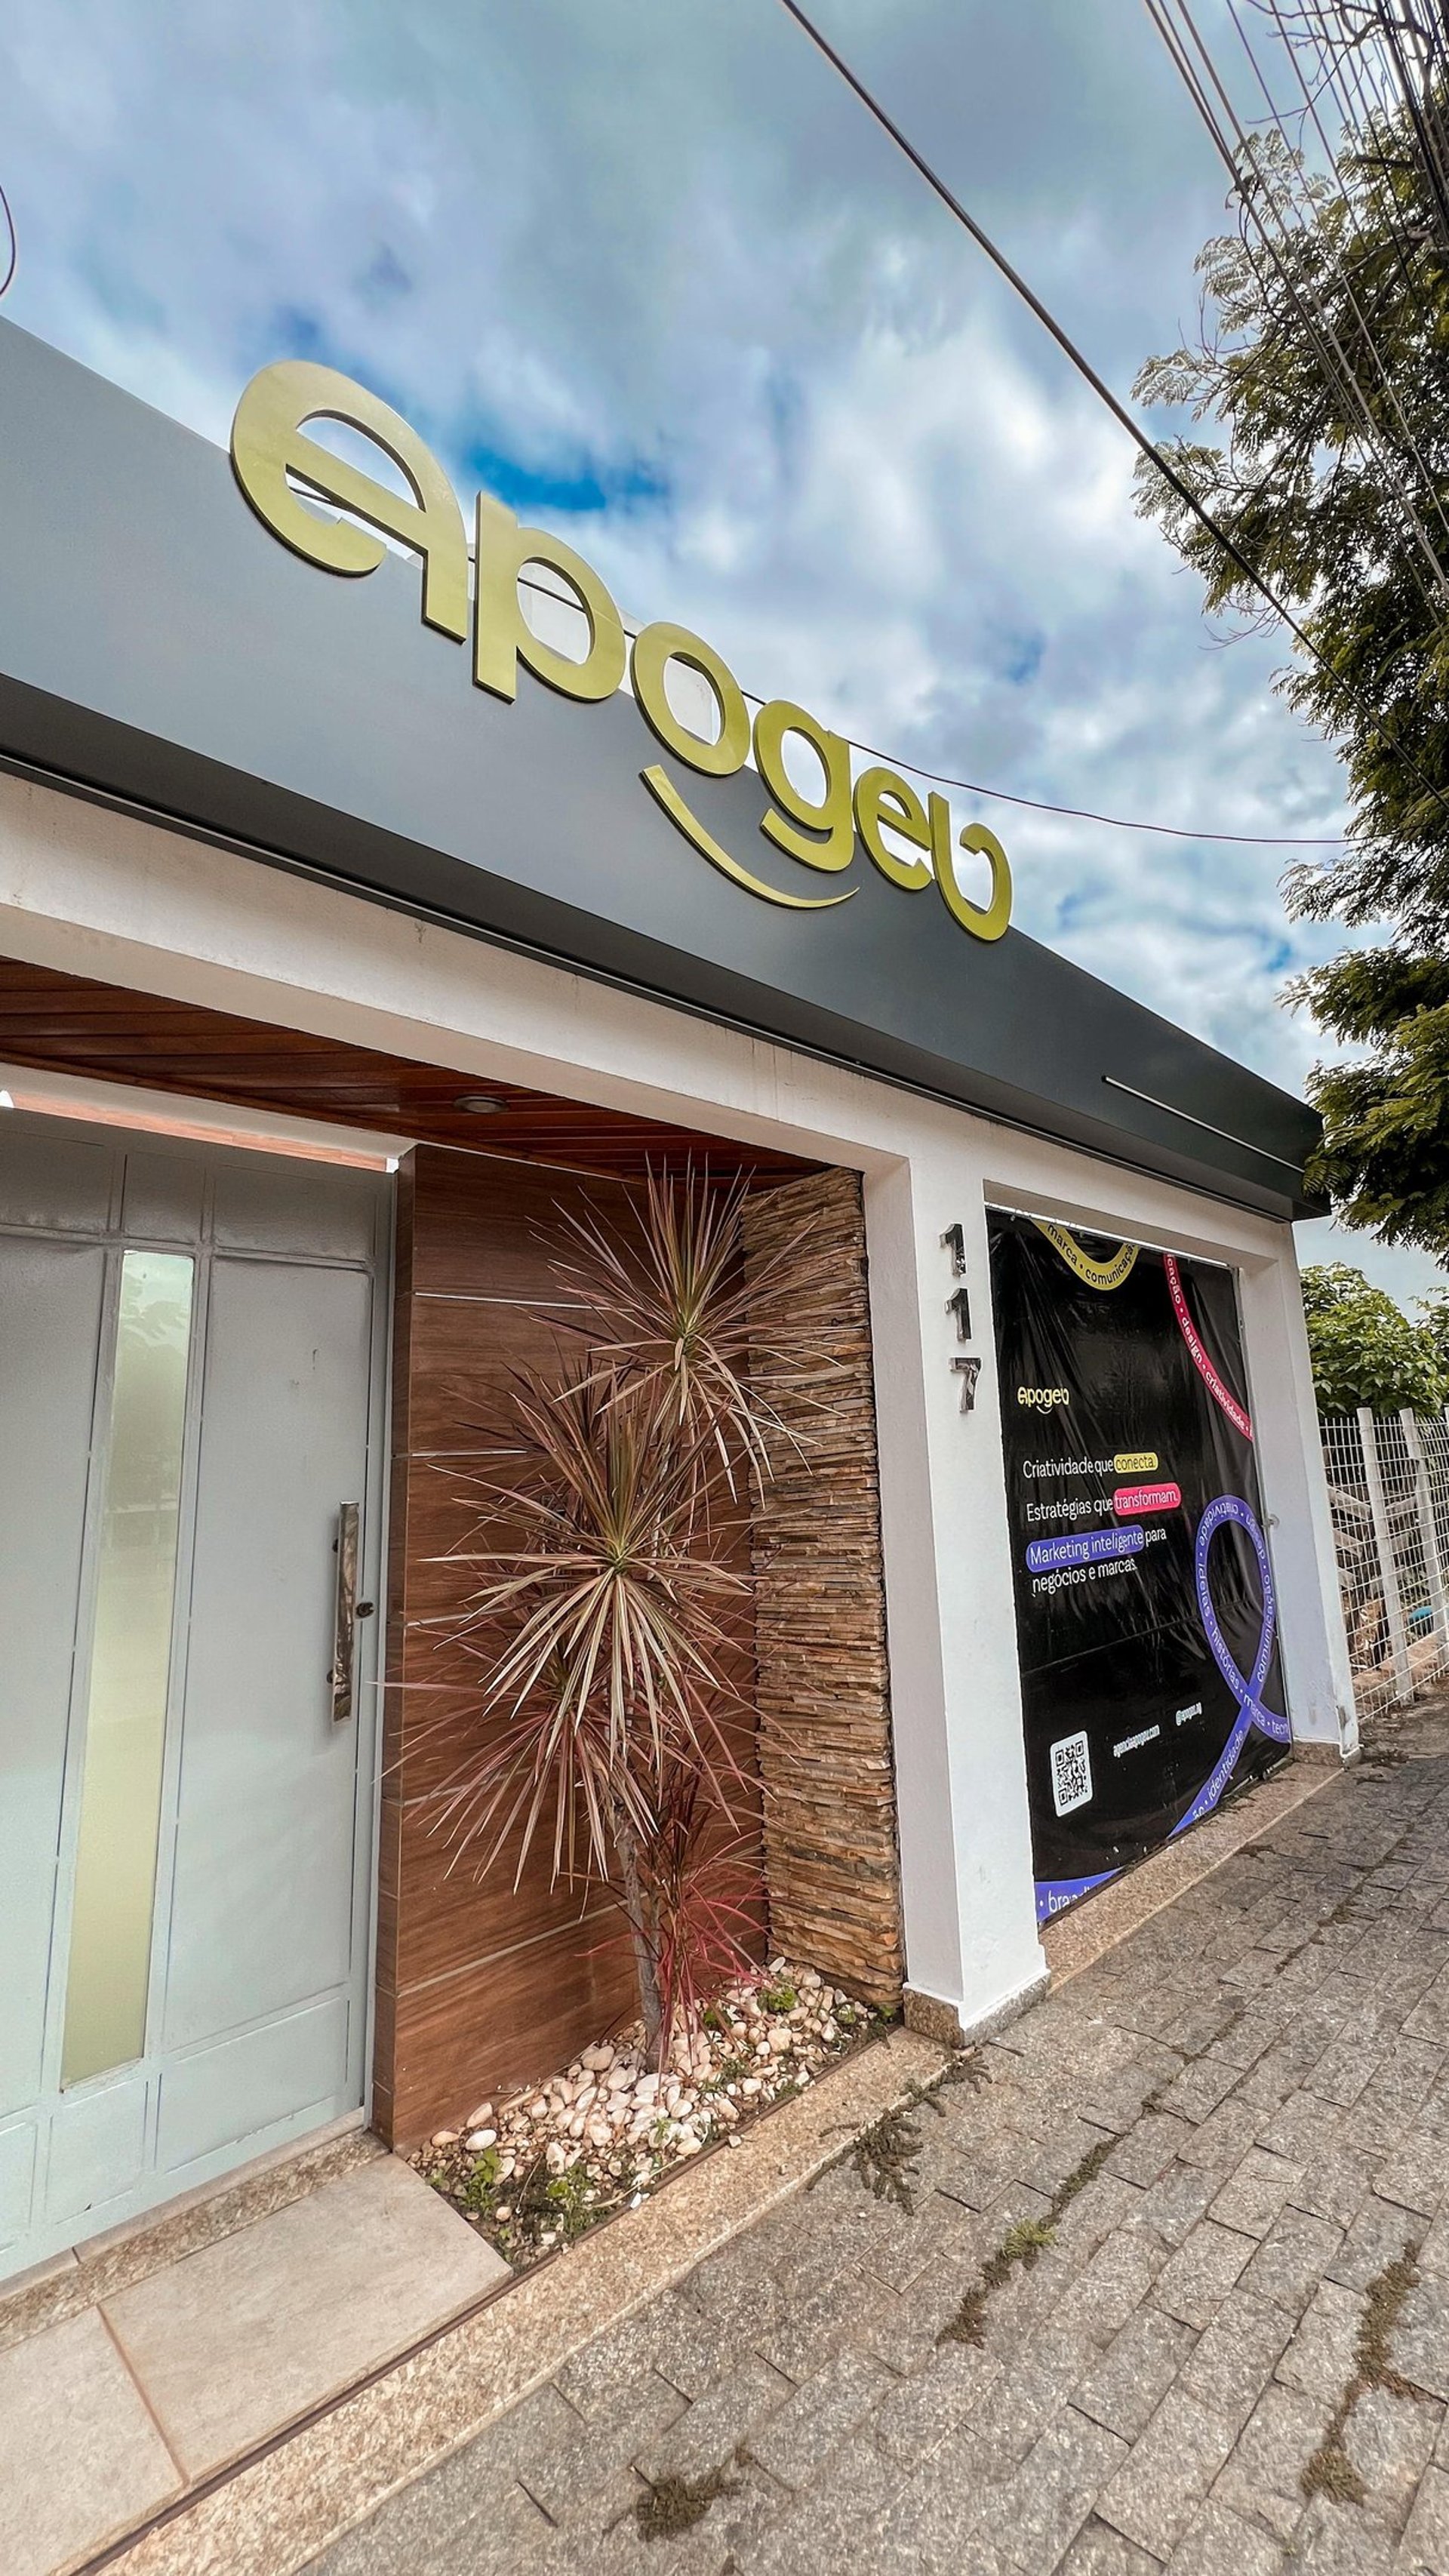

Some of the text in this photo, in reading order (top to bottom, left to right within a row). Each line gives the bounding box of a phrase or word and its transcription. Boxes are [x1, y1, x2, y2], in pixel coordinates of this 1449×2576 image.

[1047, 1224, 1078, 1266] marca
[1181, 1317, 1203, 1364] design
[1205, 1371, 1245, 1430] criatividade
[1023, 1457, 1094, 1479] Criatividade
[1094, 1458, 1114, 1476] que
[1026, 1498, 1092, 1522] Estratégias
[1094, 1498, 1113, 1516] que
[1198, 1502, 1239, 1547] criatividade
[1030, 1528, 1168, 1565] Marketing inteligente para
[1245, 1514, 1266, 1559] design
[1032, 1567, 1087, 1595] negócios
[1088, 1566, 1096, 1580] e
[1198, 1563, 1211, 1617] ideias
[1257, 1574, 1274, 1682] comunicação
[1211, 1627, 1241, 1690] histórias
[1243, 1694, 1266, 1727] marca
[1208, 1731, 1244, 1800] identidade
